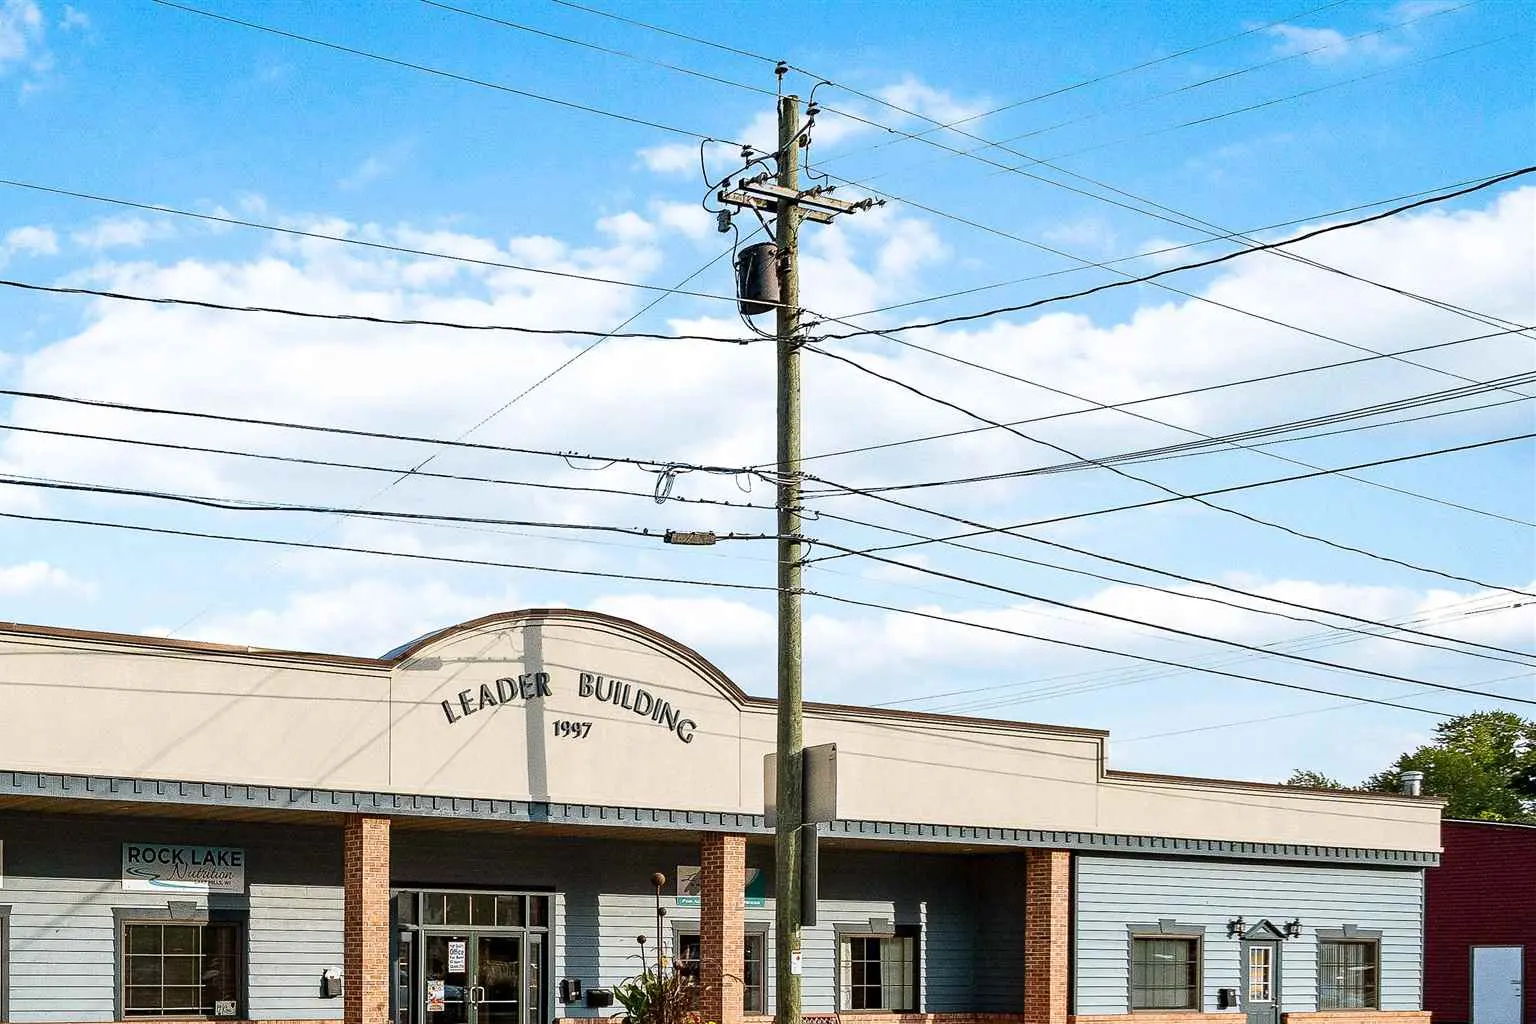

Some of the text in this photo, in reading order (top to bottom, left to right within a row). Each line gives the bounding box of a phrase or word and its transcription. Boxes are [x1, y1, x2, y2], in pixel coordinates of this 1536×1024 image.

[440, 672, 697, 744] LEADER BUILDING
[552, 719, 593, 739] 1997
[128, 846, 242, 867] ROCK LAKE
[167, 862, 234, 881] Nutrition
